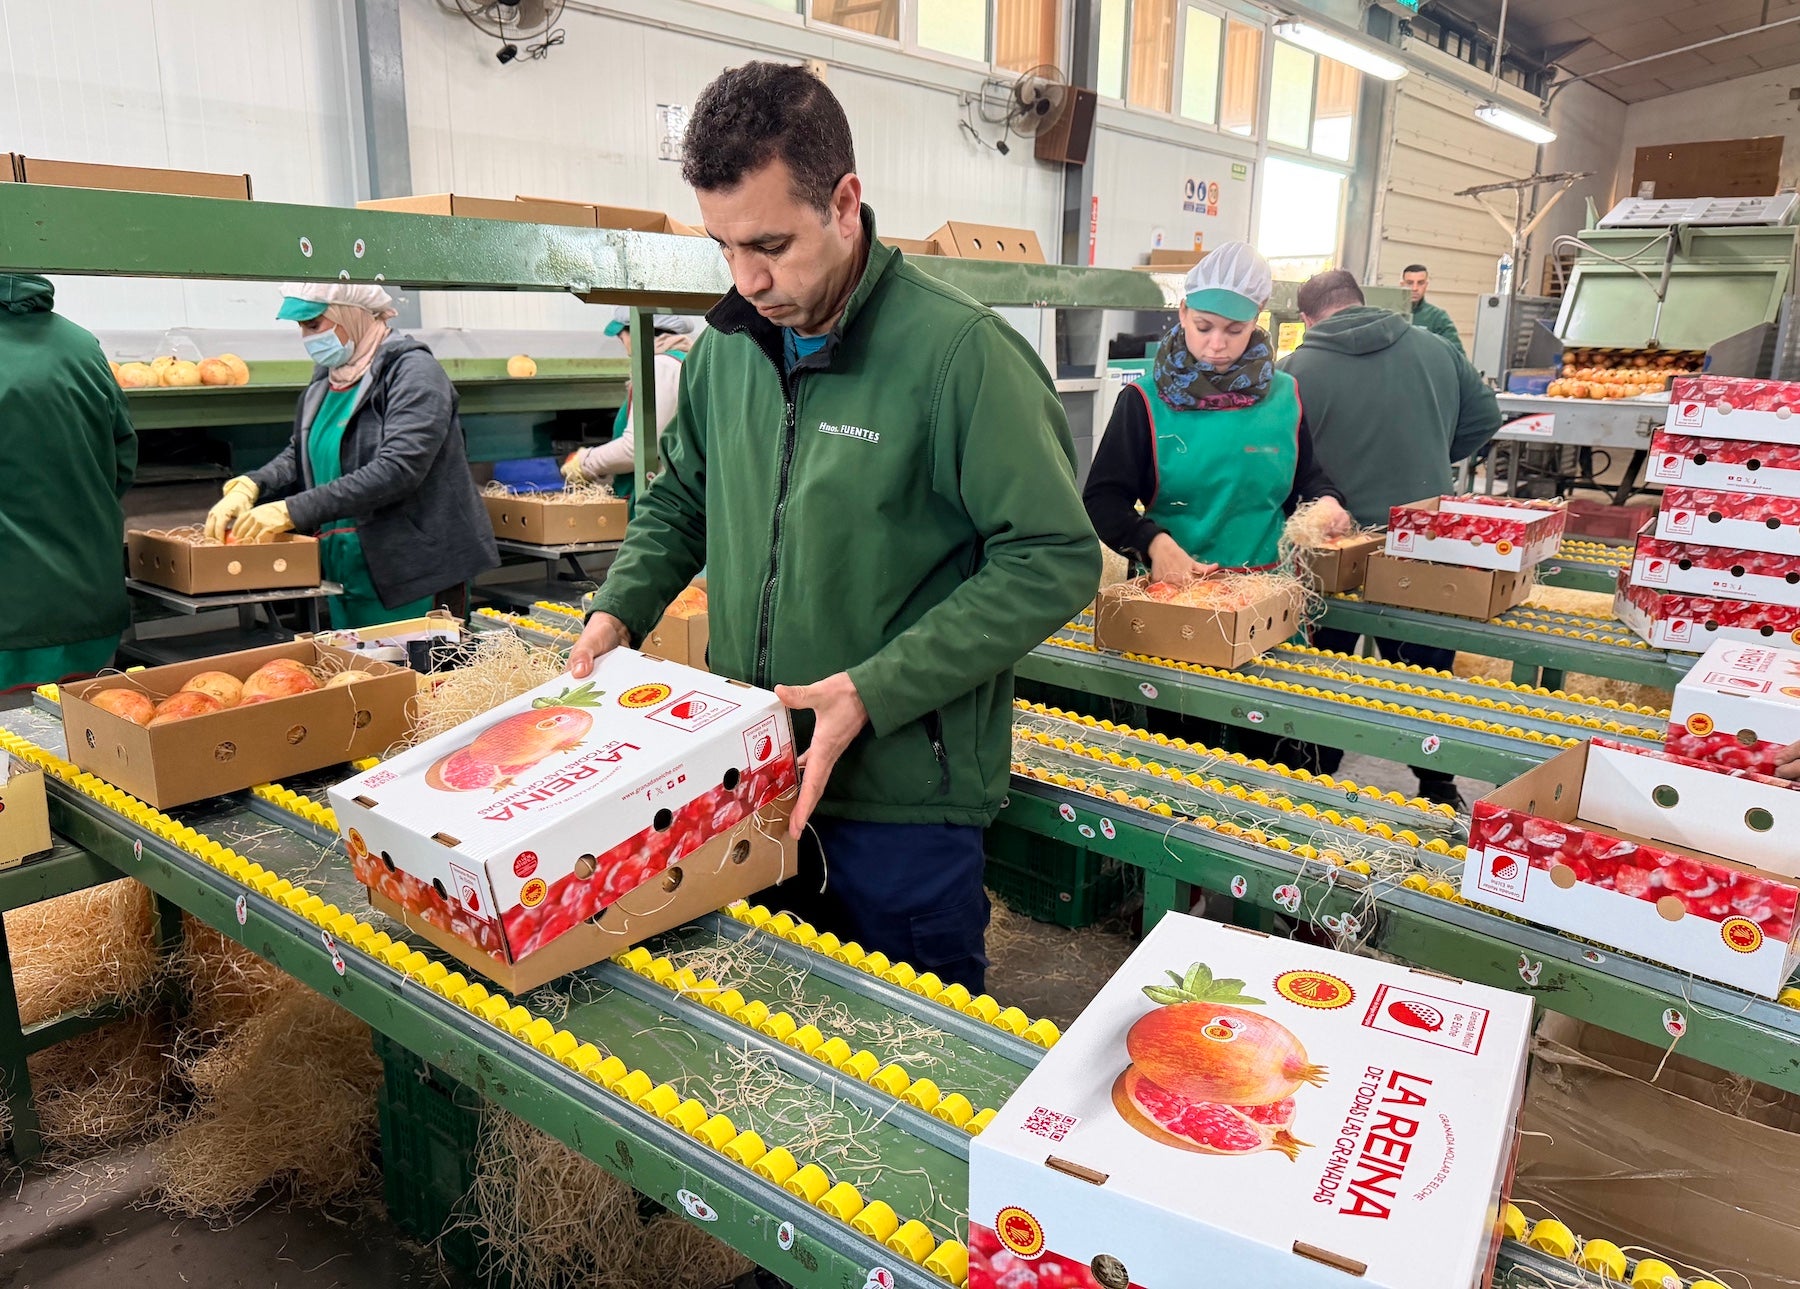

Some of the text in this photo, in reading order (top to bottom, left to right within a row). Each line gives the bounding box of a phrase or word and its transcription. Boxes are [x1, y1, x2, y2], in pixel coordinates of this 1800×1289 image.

[840, 424, 880, 441] FUENTES
[477, 740, 620, 815] DE TODAS LAS GRANADAS
[482, 742, 641, 822] LA REINA
[1448, 1013, 1464, 1037] de Elche
[1467, 1009, 1481, 1032] Granada
[1313, 1065, 1384, 1206] DE TODAS LAS GRANADAS
[1338, 1070, 1433, 1220] LA REINA
[1413, 1113, 1455, 1201] GRANADA MOLLAR DE ELCHE
